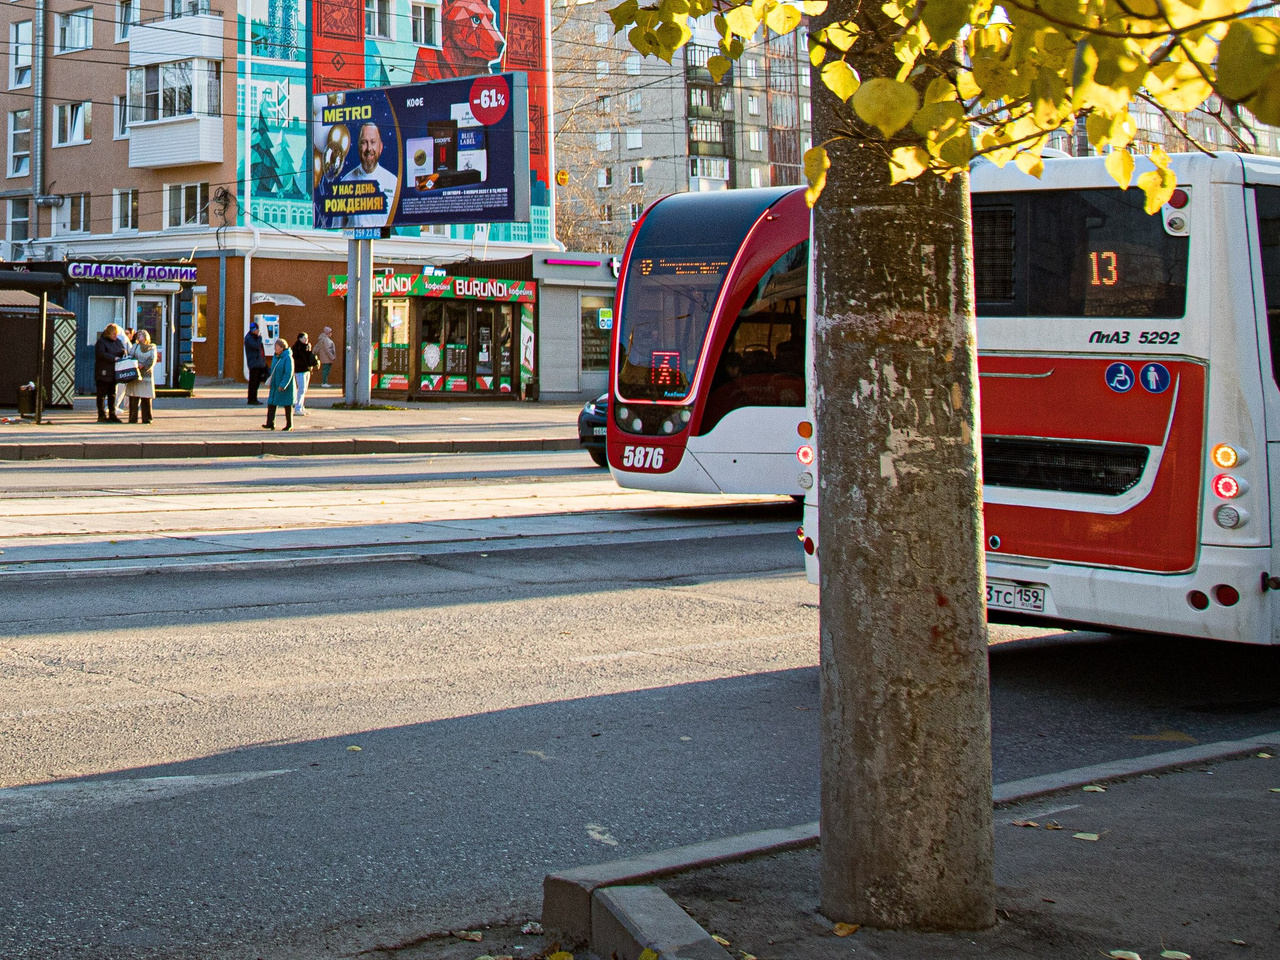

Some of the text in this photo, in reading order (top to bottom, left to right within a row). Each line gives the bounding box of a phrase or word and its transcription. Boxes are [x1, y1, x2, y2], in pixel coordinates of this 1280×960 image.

[406, 97, 424, 108] КОФЕ
[473, 89, 505, 109] -61%
[323, 105, 372, 123] METRO
[460, 138, 476, 146] LABEL
[332, 185, 338, 195] У
[339, 184, 354, 195] НАС
[355, 183, 376, 195] ДЕНЬ
[325, 196, 384, 214] РОЖДЕНИЯ!
[68, 262, 198, 282] СЛАДКИЙ ДОМИК
[1089, 251, 1118, 286] 13
[456, 279, 507, 297] BURUNDI
[1138, 331, 1181, 345] 5292
[623, 445, 665, 469] 5876
[1017, 588, 1040, 604] 159
